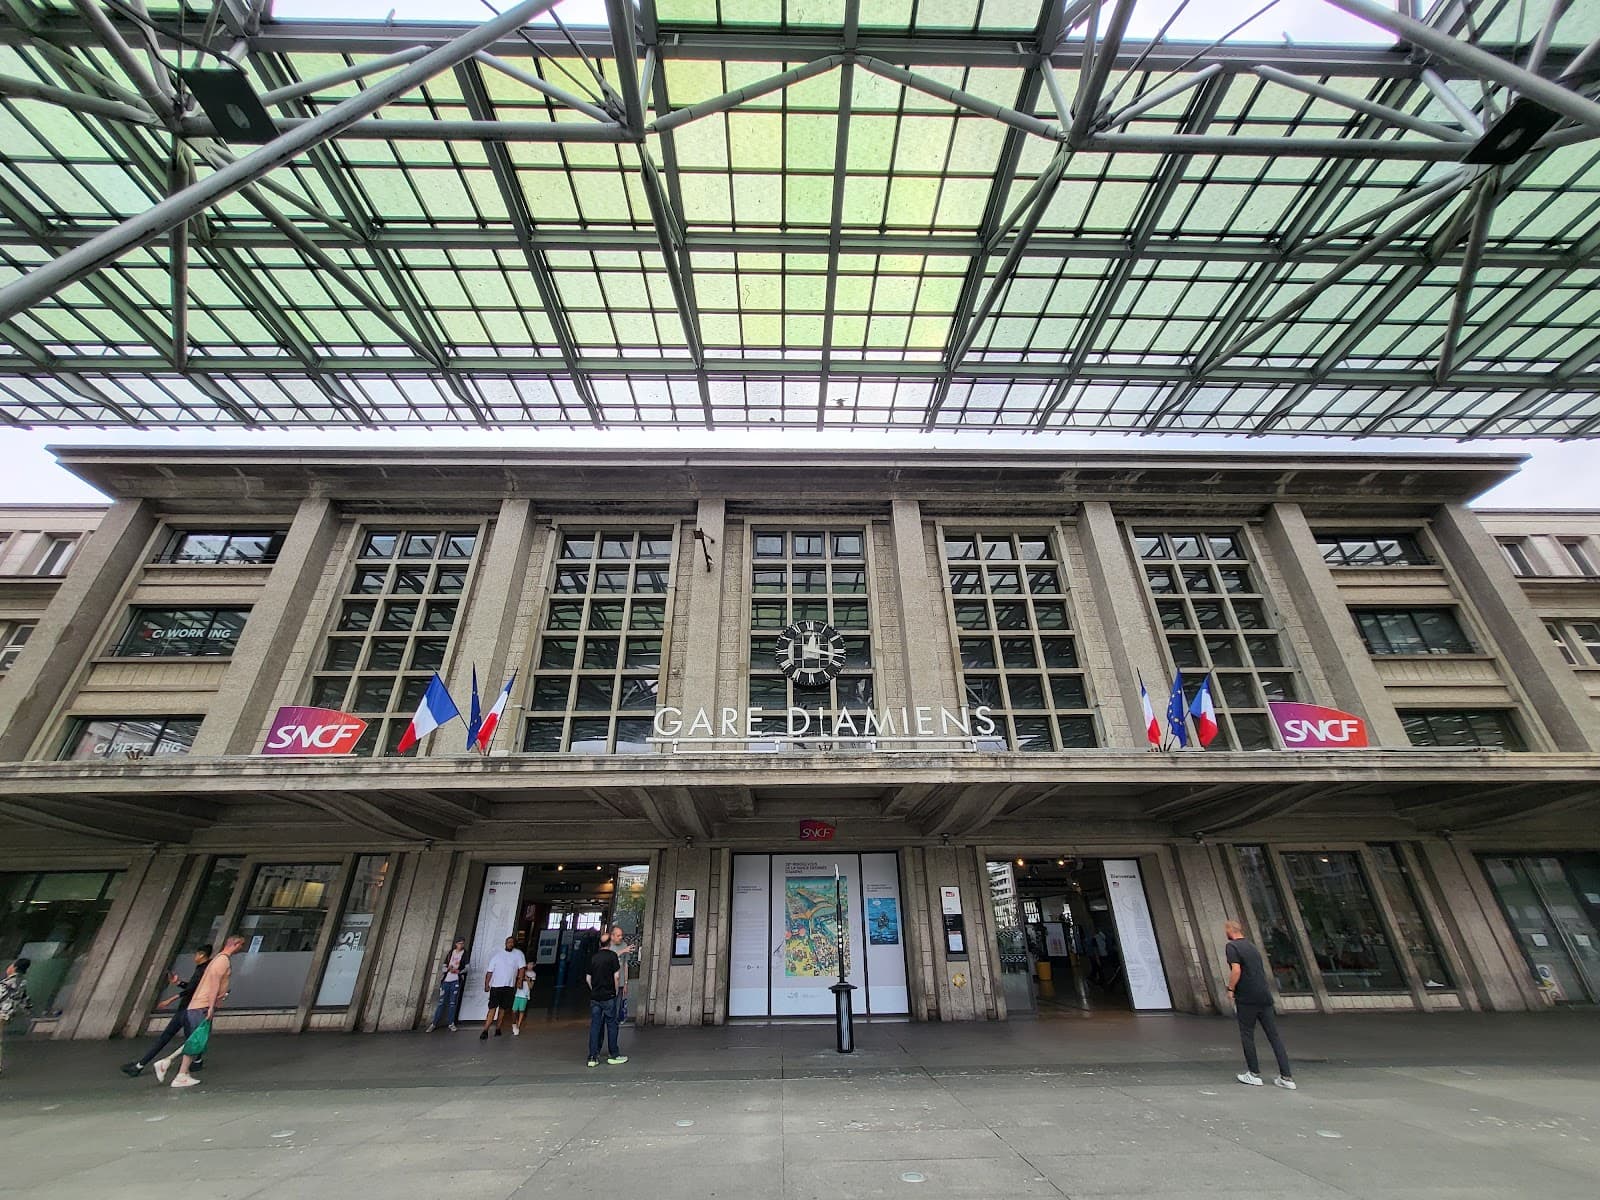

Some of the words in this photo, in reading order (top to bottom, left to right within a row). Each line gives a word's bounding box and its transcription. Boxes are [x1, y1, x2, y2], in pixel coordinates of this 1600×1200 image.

[653, 707, 763, 736] GARE
[788, 707, 995, 736] D'AMIENS
[1284, 720, 1358, 742] SNCF
[268, 724, 359, 749] SNCF
[802, 828, 831, 838] SNCF
